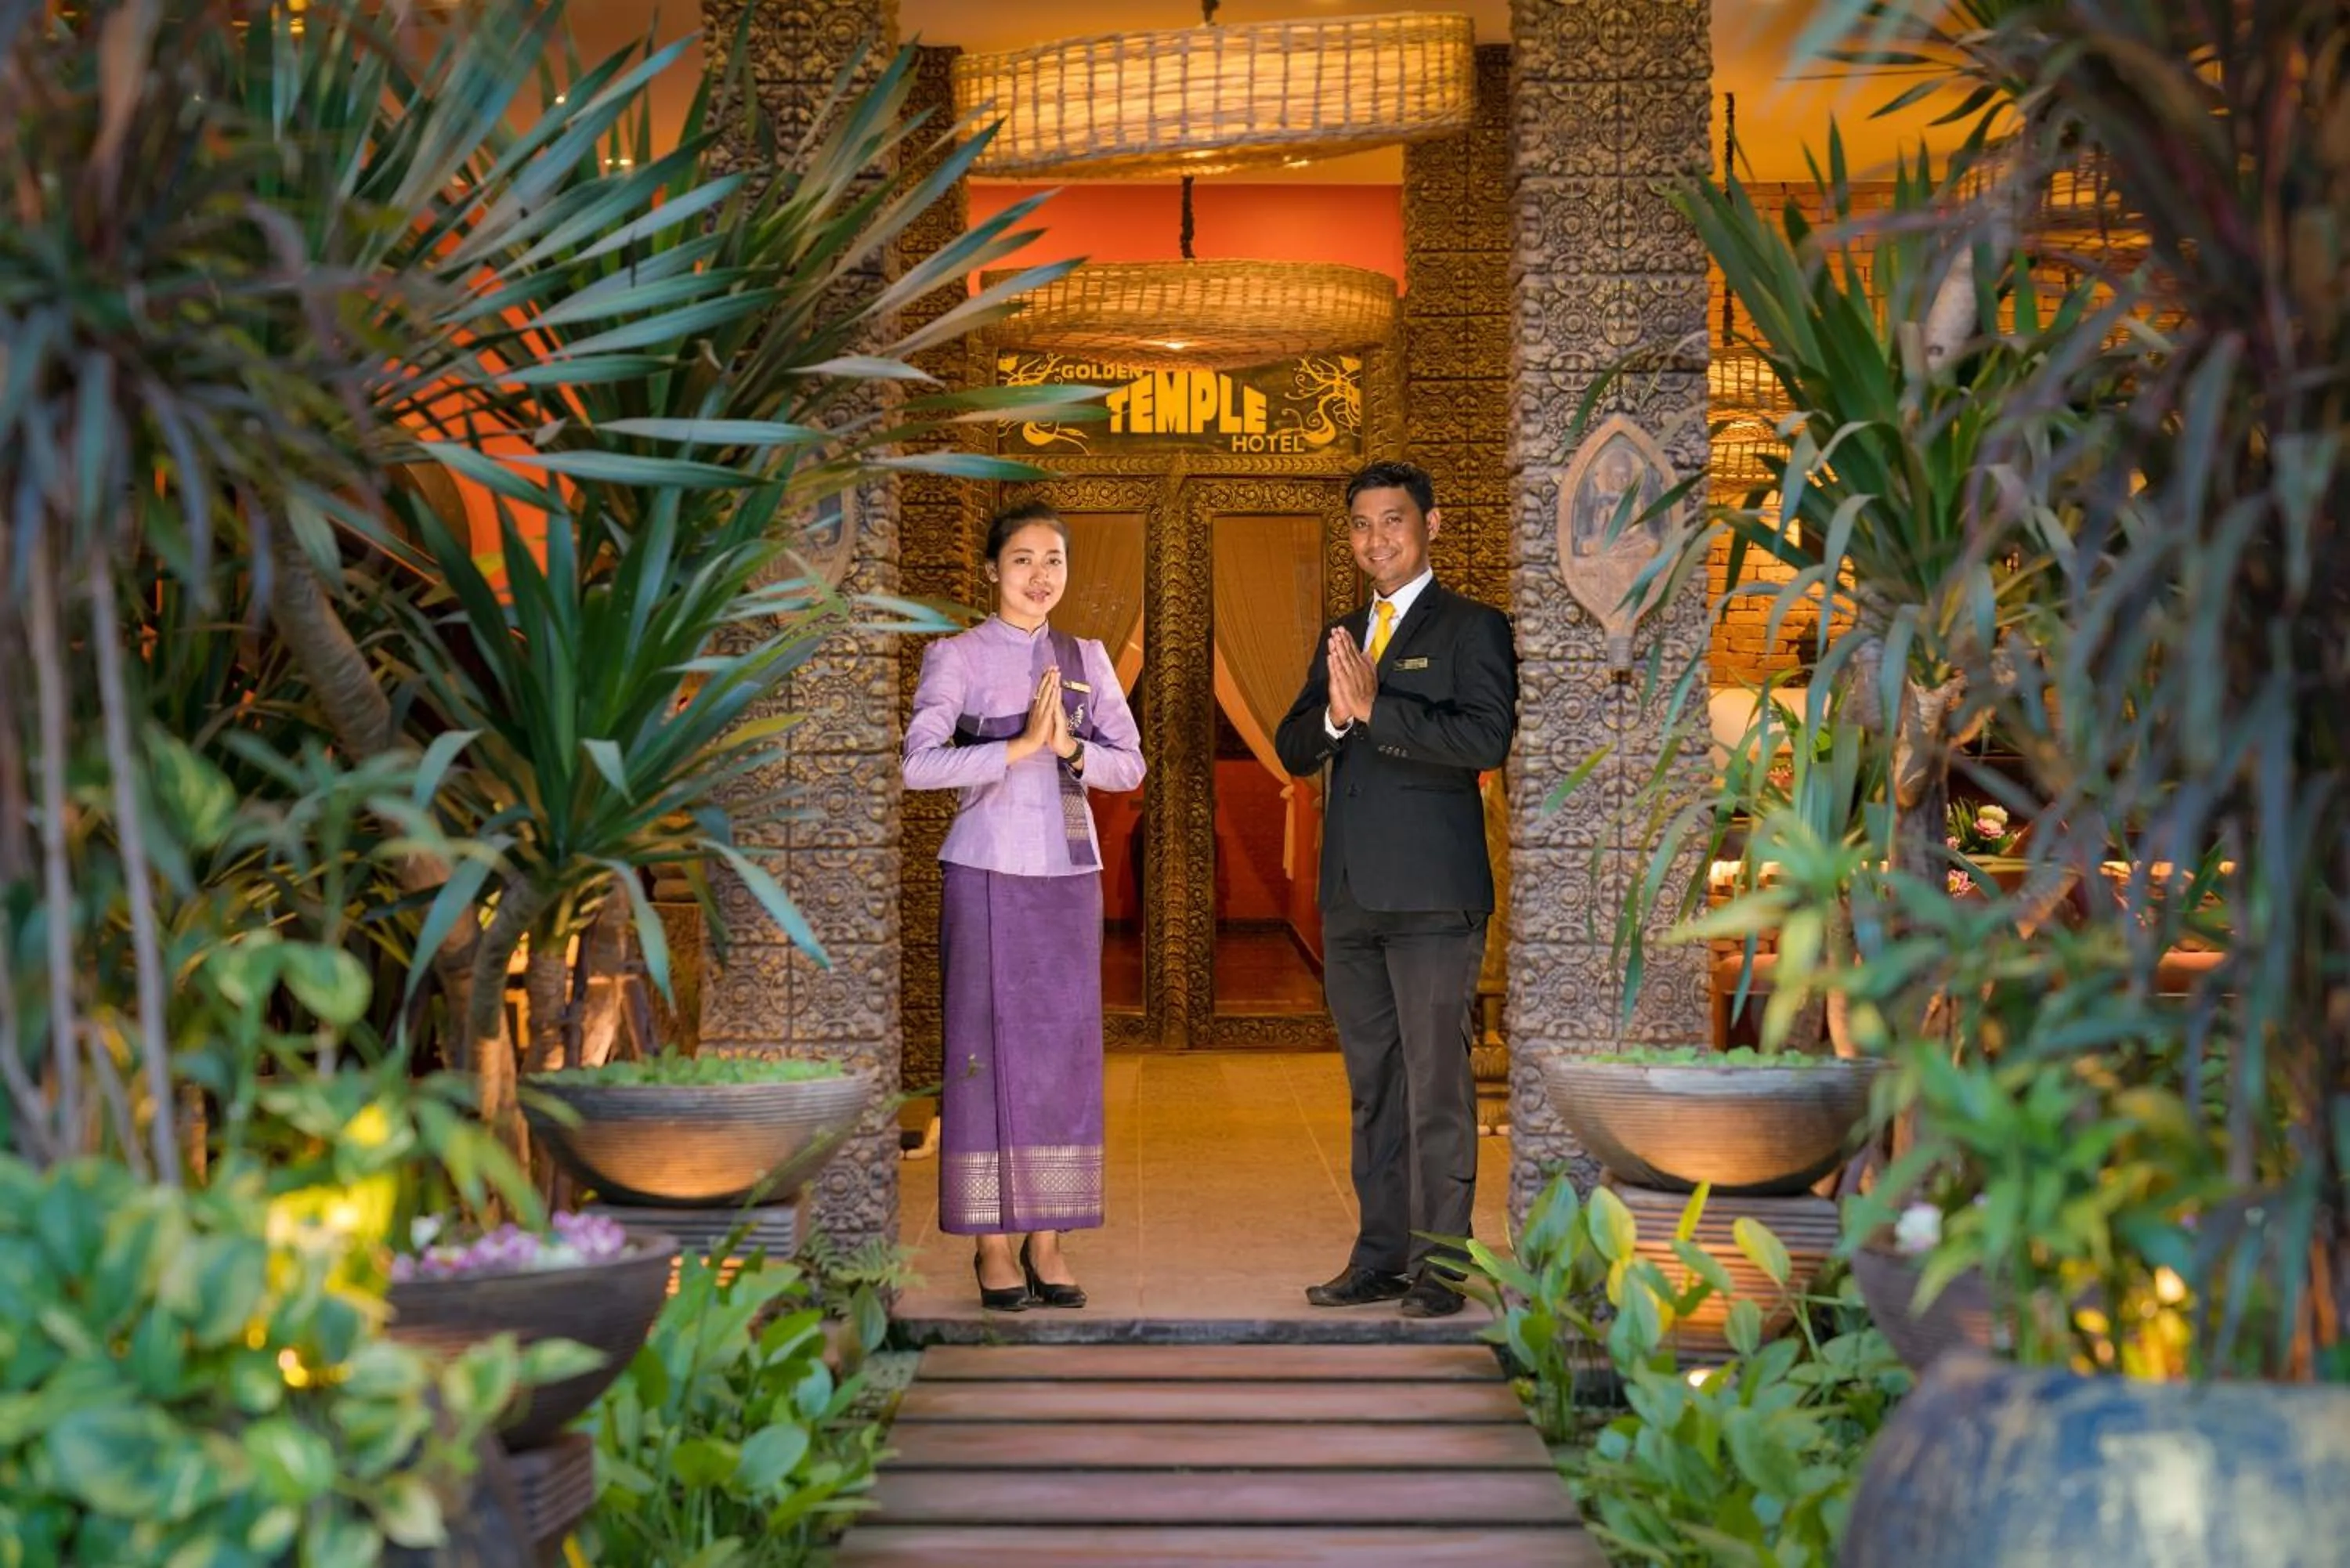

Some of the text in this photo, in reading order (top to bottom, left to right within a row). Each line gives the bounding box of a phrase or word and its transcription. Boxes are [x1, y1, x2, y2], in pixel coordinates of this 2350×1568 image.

[1061, 363, 1144, 380] GOLDEN
[1106, 367, 1267, 433] TEMPLE
[1232, 435, 1304, 453] HOTEL
